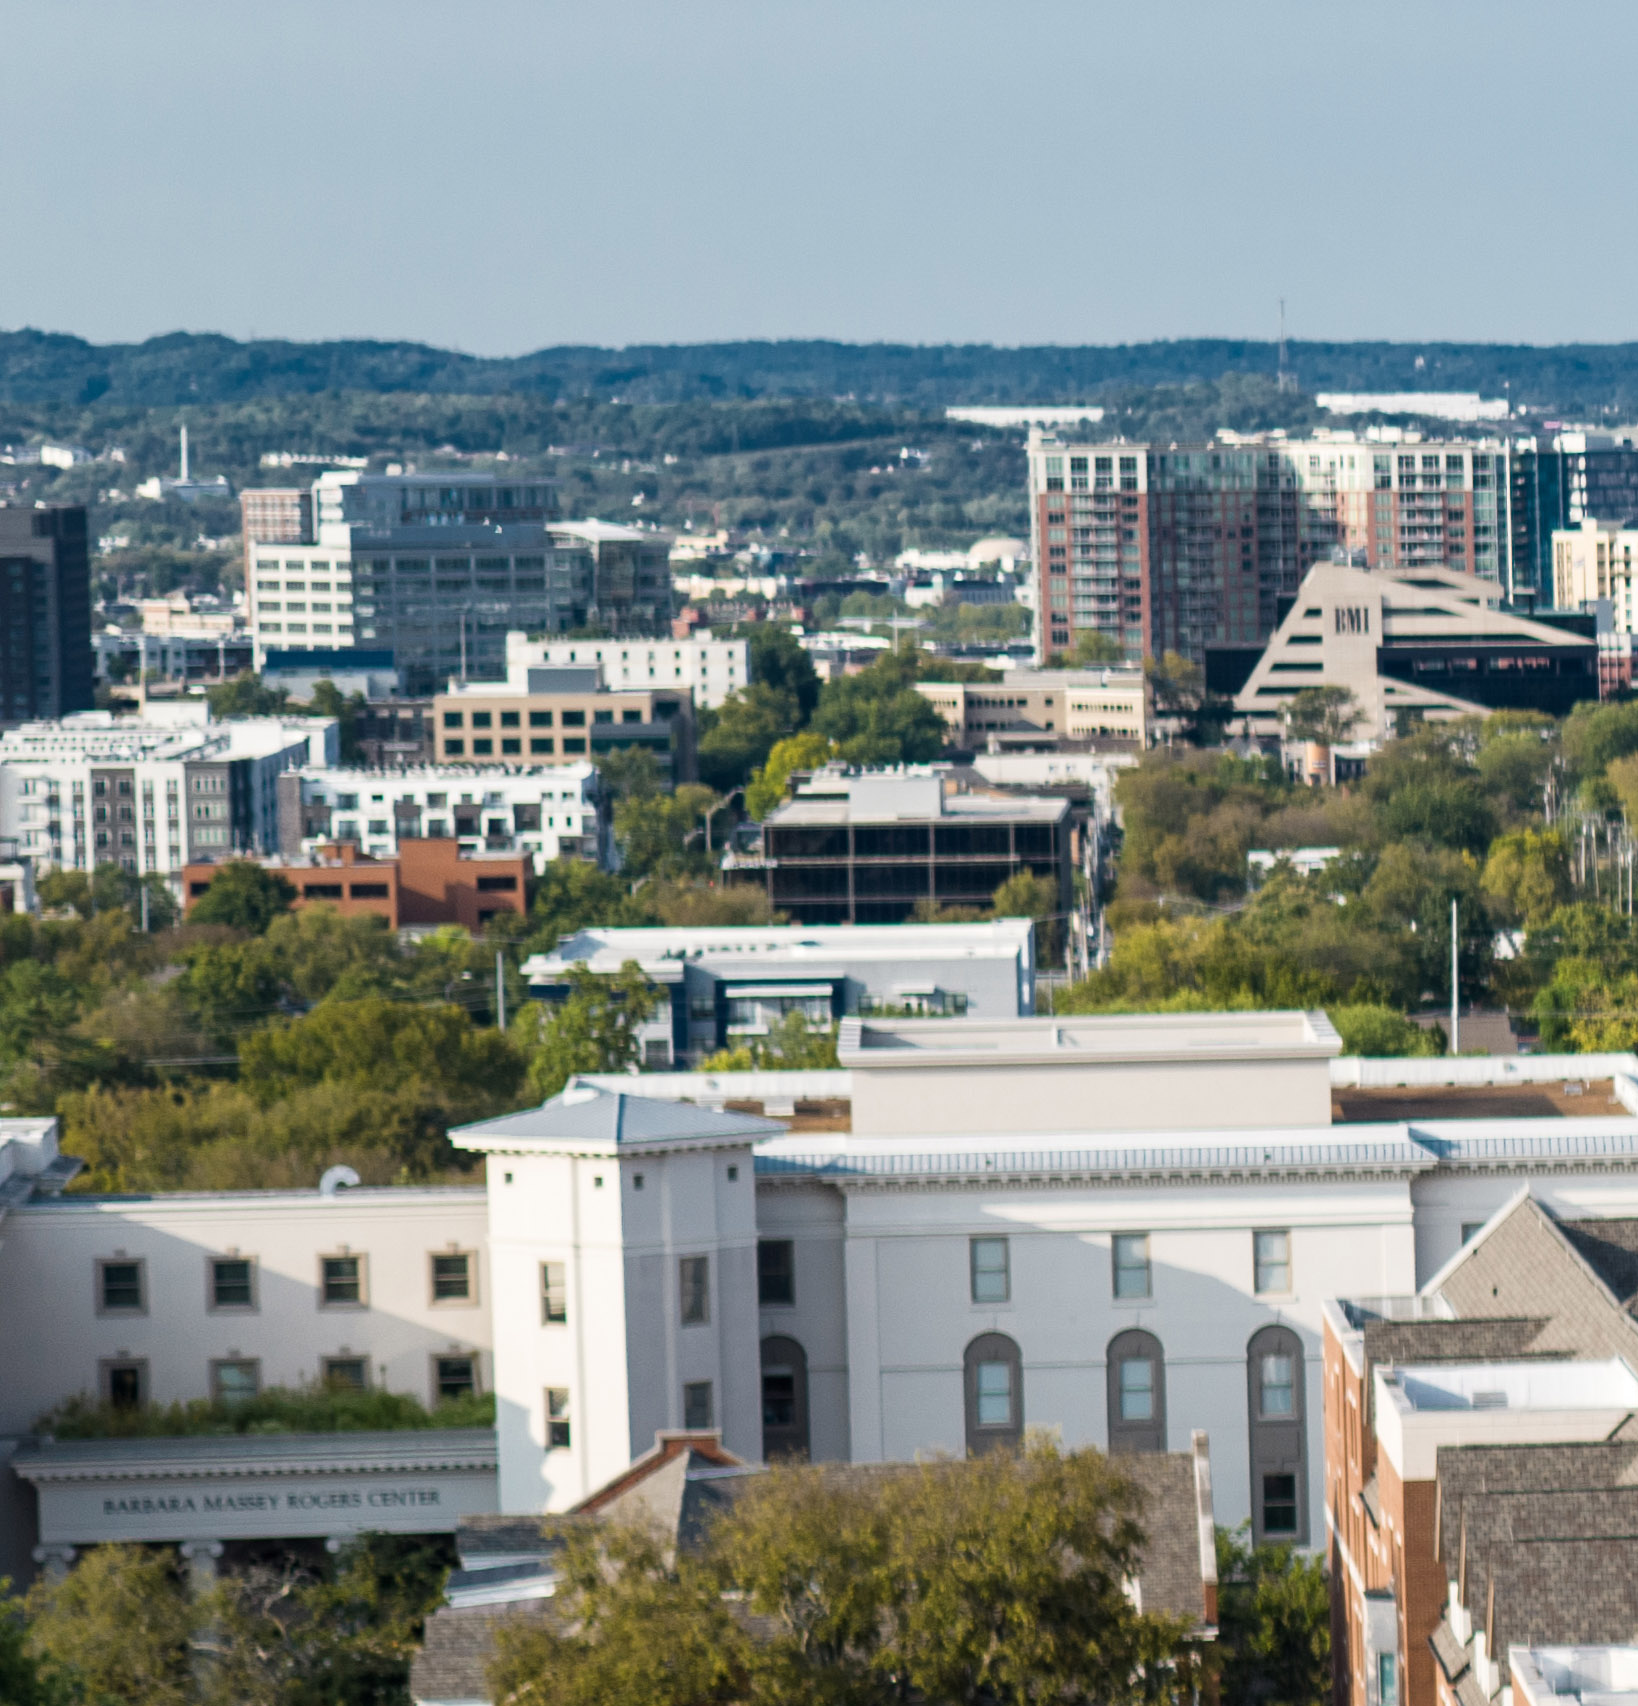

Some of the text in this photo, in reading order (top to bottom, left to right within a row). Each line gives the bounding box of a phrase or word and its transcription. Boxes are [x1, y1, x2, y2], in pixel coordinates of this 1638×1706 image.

[1335, 607, 1369, 634] BMI
[103, 1487, 441, 1515] BARBARA MASSEY ROGERS CENTER
